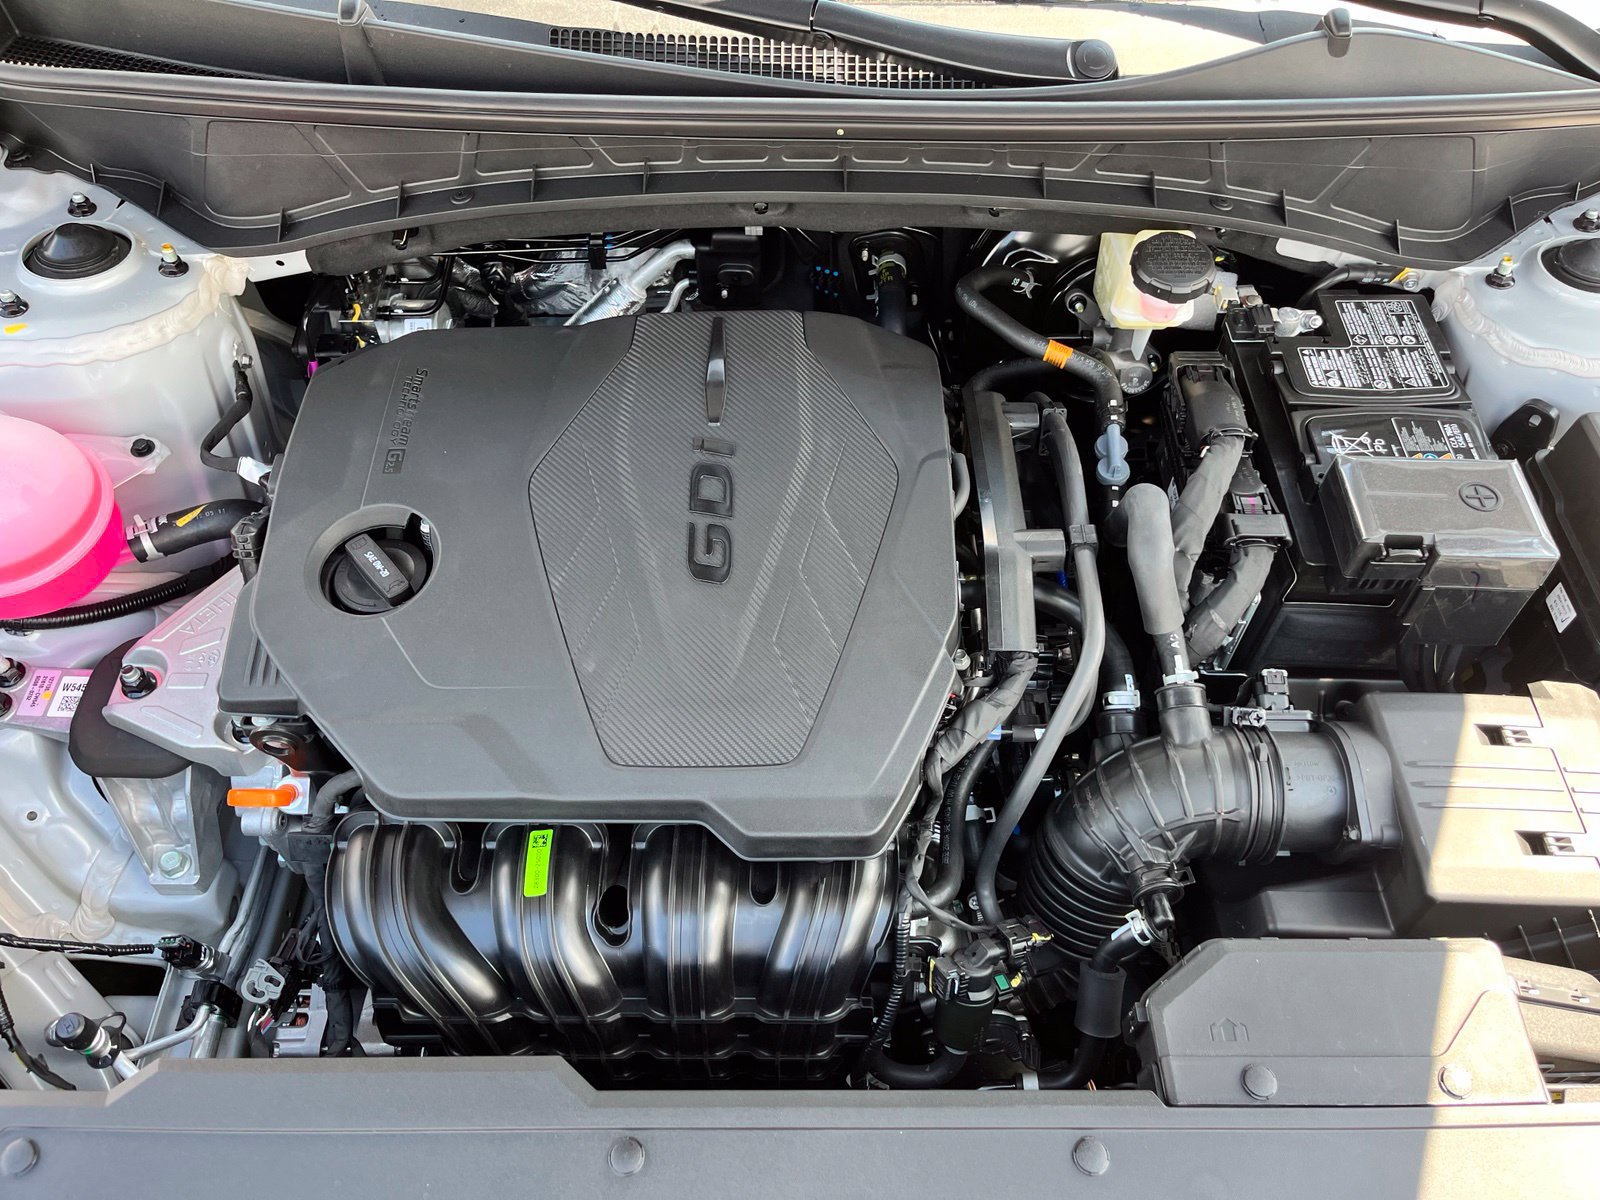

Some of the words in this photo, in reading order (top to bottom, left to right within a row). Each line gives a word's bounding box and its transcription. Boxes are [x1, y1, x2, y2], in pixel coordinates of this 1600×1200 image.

[399, 367, 428, 447] Smartstream
[364, 551, 378, 563] SAE
[373, 560, 390, 578] 0W-20
